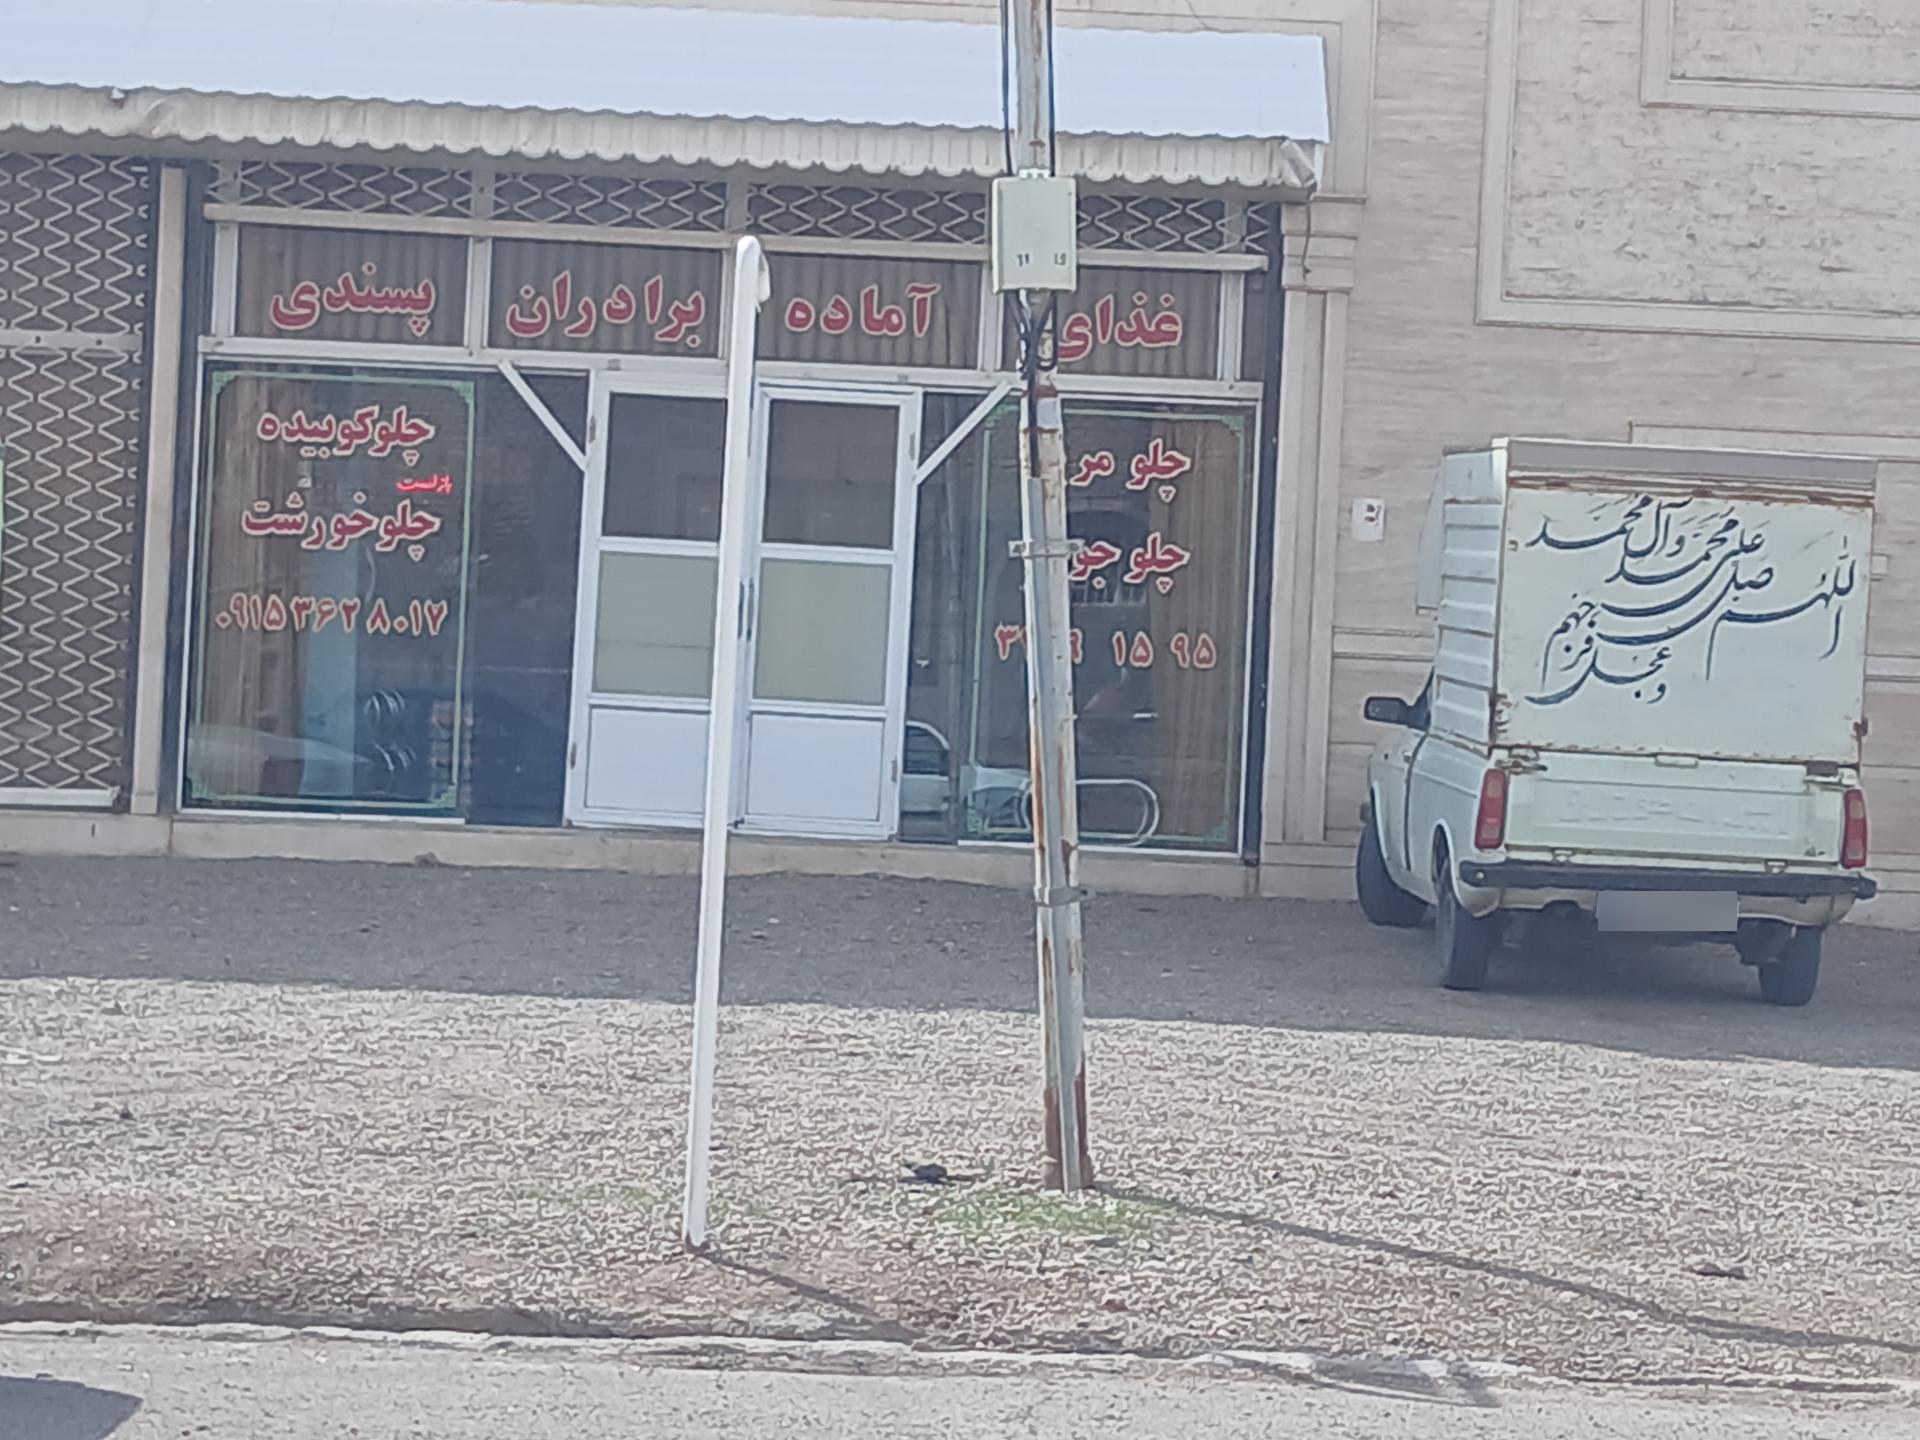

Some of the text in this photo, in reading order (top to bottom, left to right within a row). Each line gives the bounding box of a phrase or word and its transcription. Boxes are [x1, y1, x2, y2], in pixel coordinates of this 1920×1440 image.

[270, 261, 1183, 362] غذای آماده برادران پسندی
[1069, 437, 1192, 503] چلو مر
[1122, 531, 1192, 595] چلو
